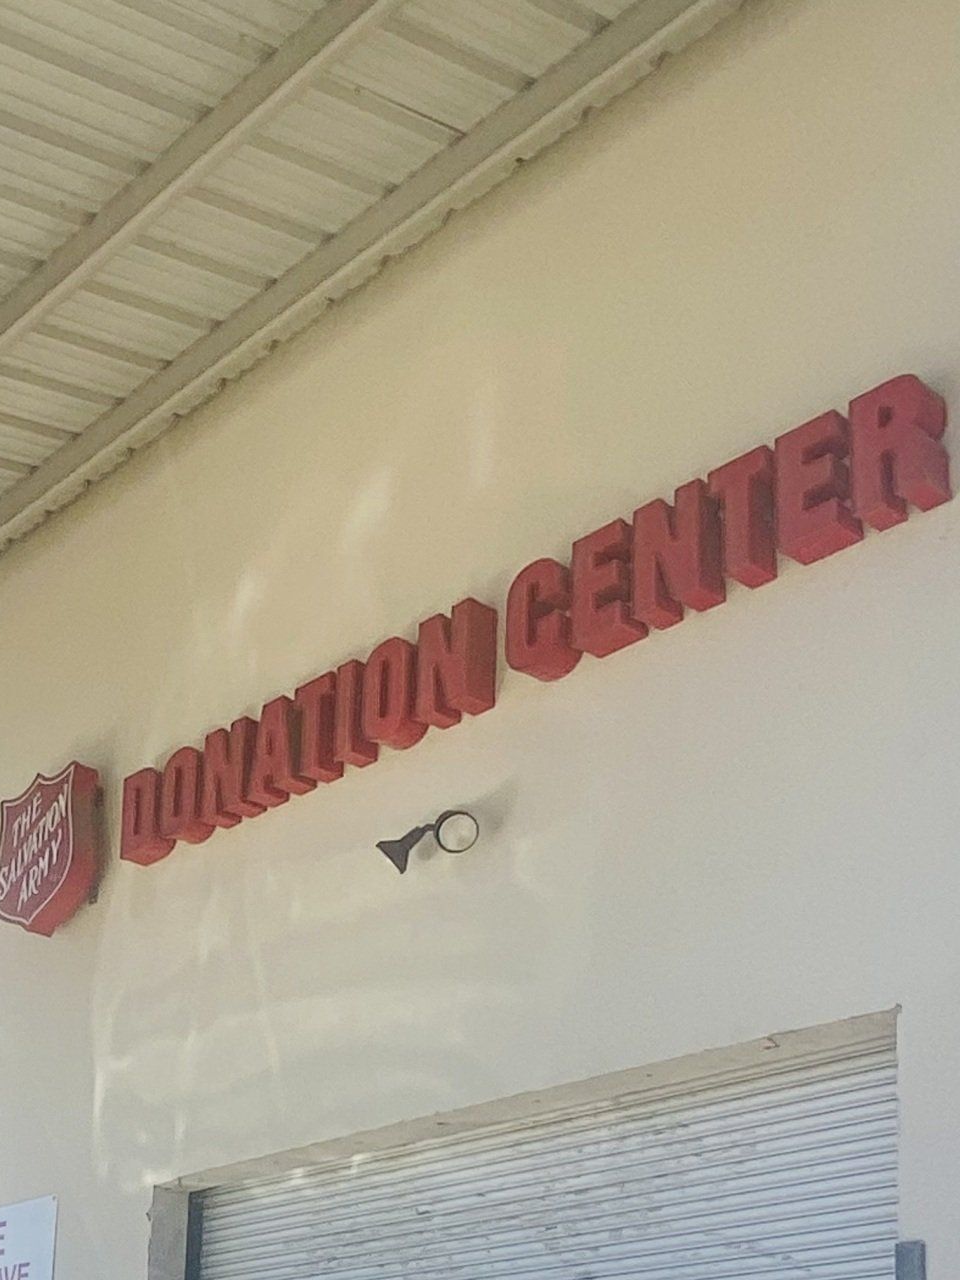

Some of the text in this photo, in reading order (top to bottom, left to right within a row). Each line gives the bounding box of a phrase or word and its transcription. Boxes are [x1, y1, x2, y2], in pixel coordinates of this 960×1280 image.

[120, 373, 951, 867] DONATION CENTER
[12, 791, 42, 847] THE
[17, 828, 62, 912] ARMY
